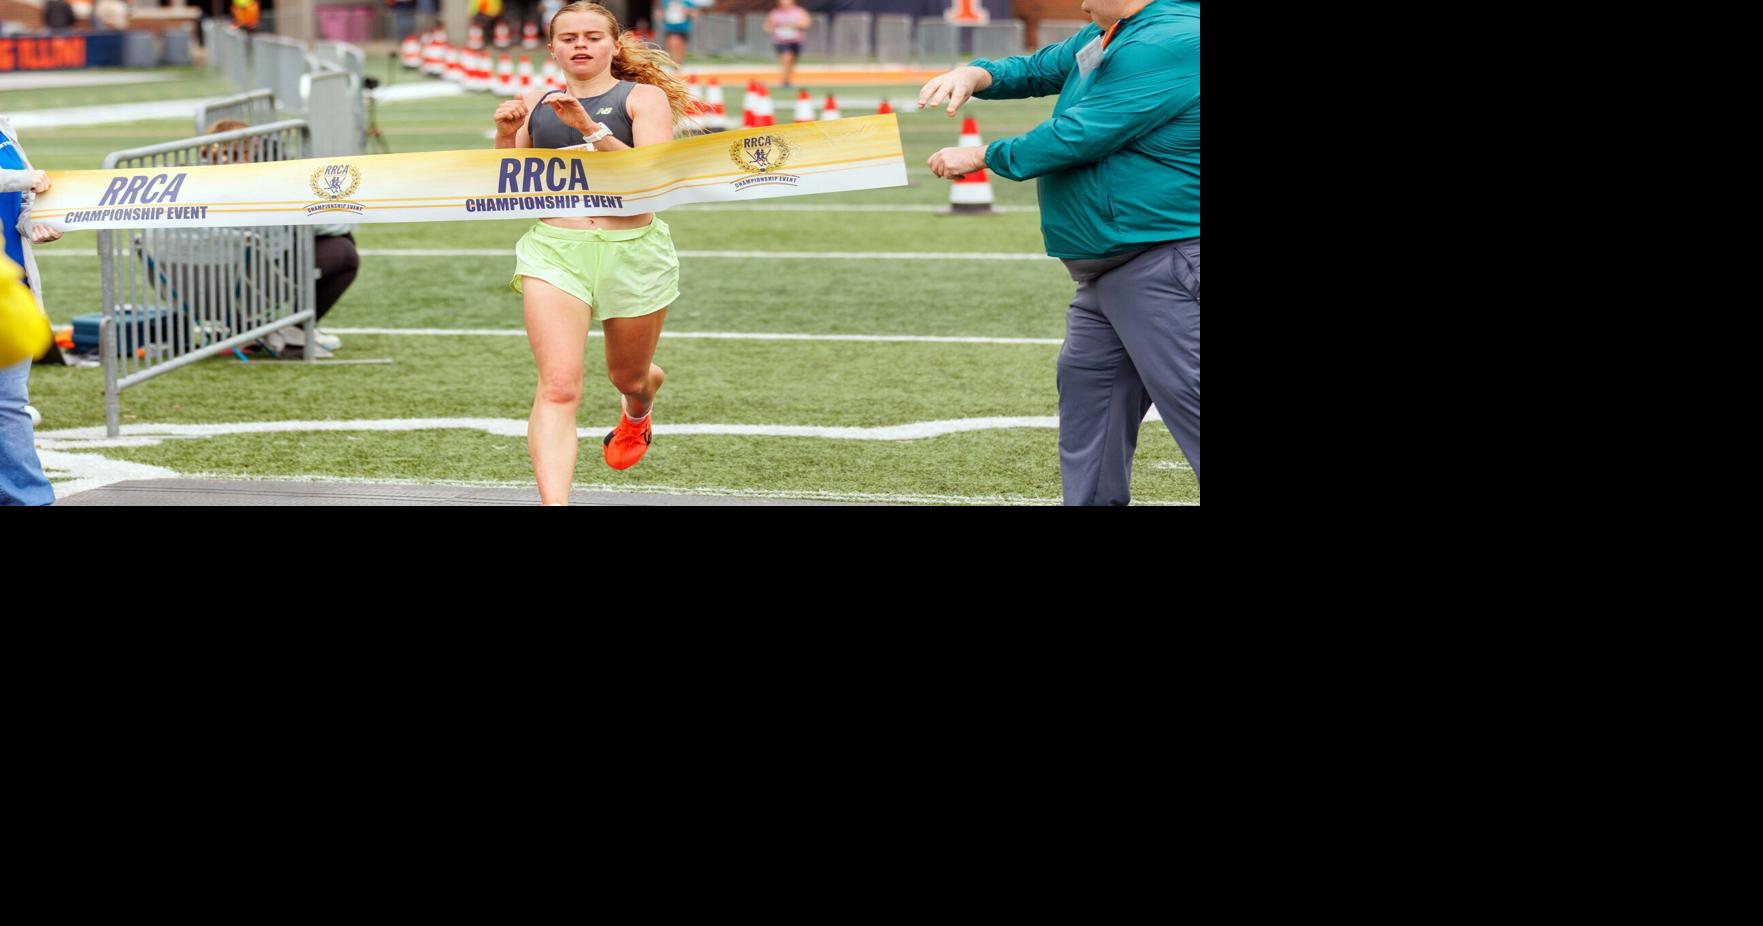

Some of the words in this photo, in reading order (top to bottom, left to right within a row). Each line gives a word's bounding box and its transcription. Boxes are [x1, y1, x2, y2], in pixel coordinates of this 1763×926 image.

[744, 136, 772, 148] RRCA
[325, 164, 349, 175] RRCA
[498, 157, 589, 193] RRCA
[735, 176, 778, 188] CHAMPIONSHIP
[98, 173, 187, 207] RRCA
[307, 203, 346, 213] CHAMPIONSHIP
[347, 203, 363, 211] EVENT
[466, 195, 579, 212] CHAMPIONSHIP
[583, 195, 623, 210] EVENT
[64, 207, 164, 224] CHAMPIONSHIP
[167, 206, 208, 220] EVENT
